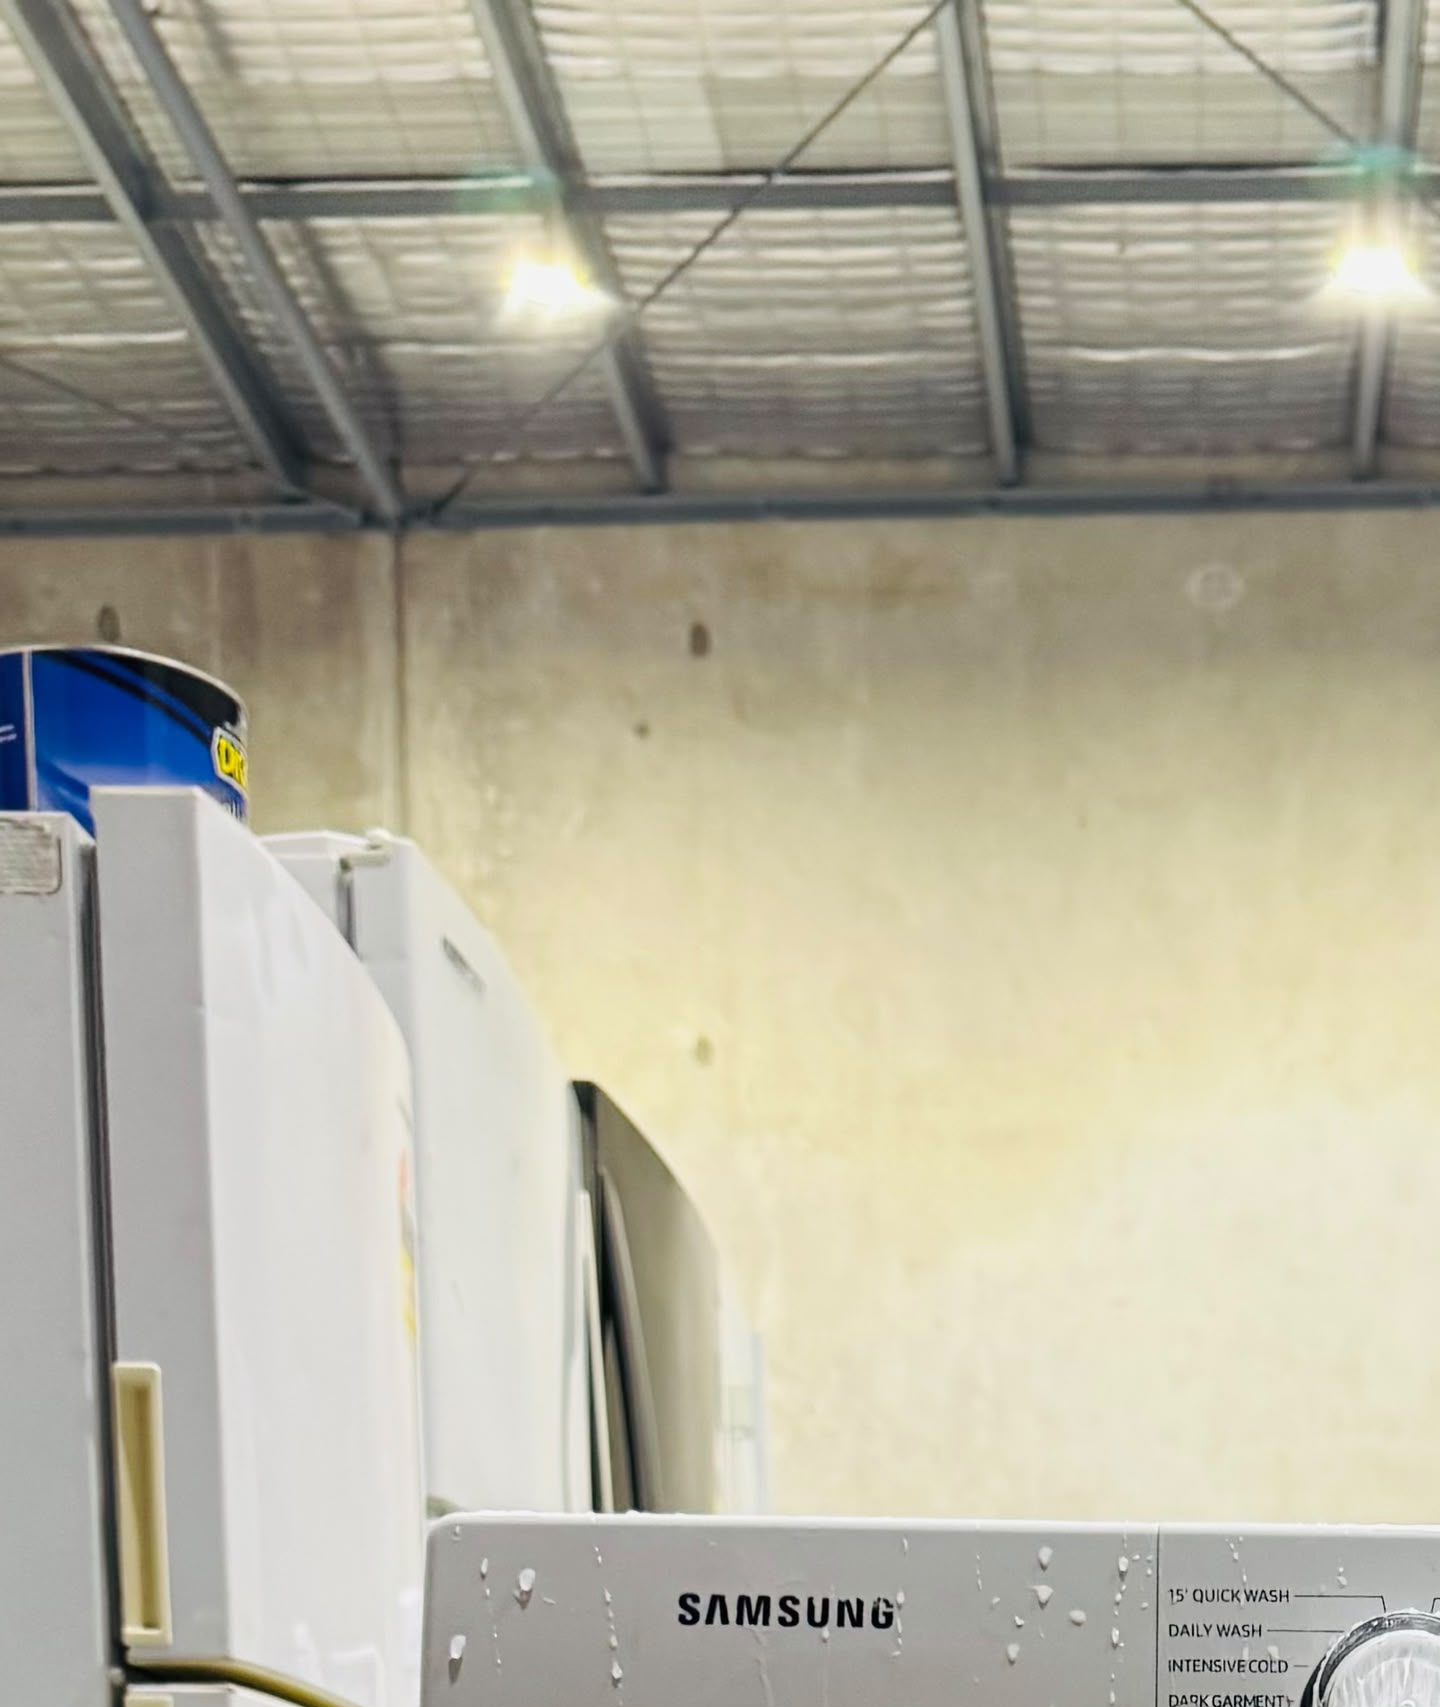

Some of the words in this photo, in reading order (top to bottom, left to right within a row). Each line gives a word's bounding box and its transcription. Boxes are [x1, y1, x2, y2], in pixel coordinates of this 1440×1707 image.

[1168, 1588, 1188, 1603] 15'
[1192, 1588, 1240, 1603] QUICK
[1244, 1588, 1290, 1603] WASH
[678, 1592, 895, 1630] SAMSUNG
[1168, 1623, 1213, 1638] DAILY
[1216, 1623, 1262, 1638] WASH
[1168, 1659, 1246, 1673] INTENSIVE
[1248, 1659, 1289, 1673] COLD
